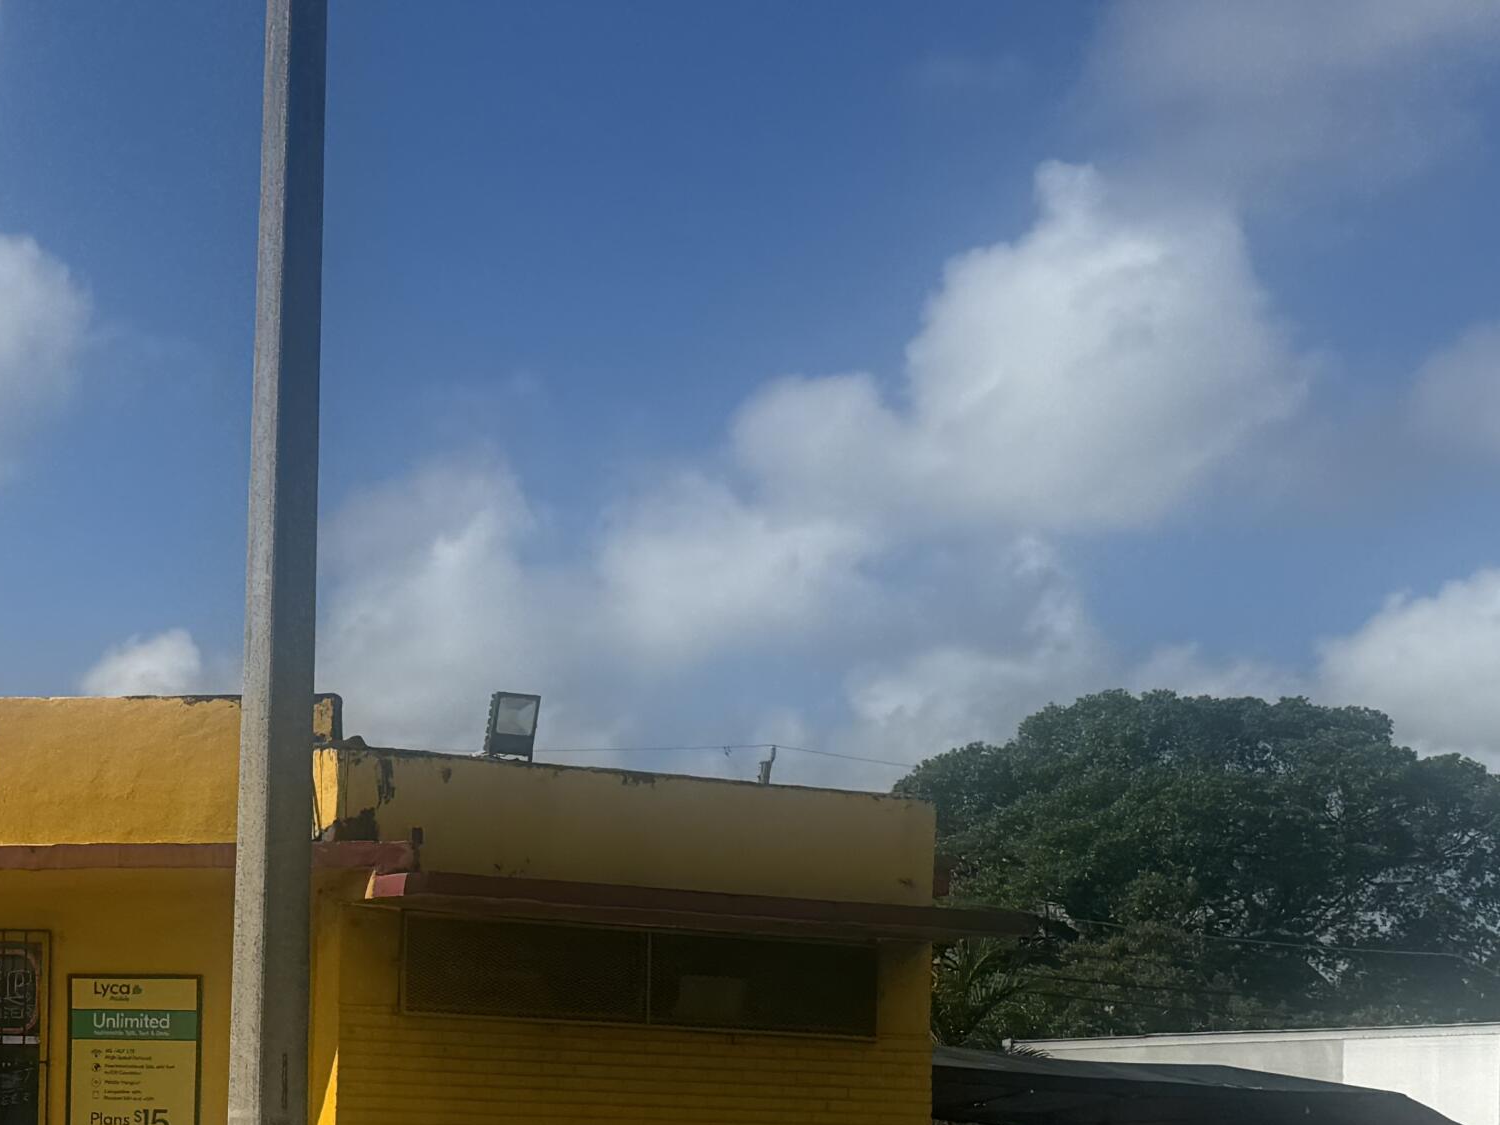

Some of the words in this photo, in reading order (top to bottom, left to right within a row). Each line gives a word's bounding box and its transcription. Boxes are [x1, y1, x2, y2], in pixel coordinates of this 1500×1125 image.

[94, 981, 131, 997] Lyca
[93, 1012, 170, 1029] Unlimited
[90, 1112, 130, 1125] Plans
